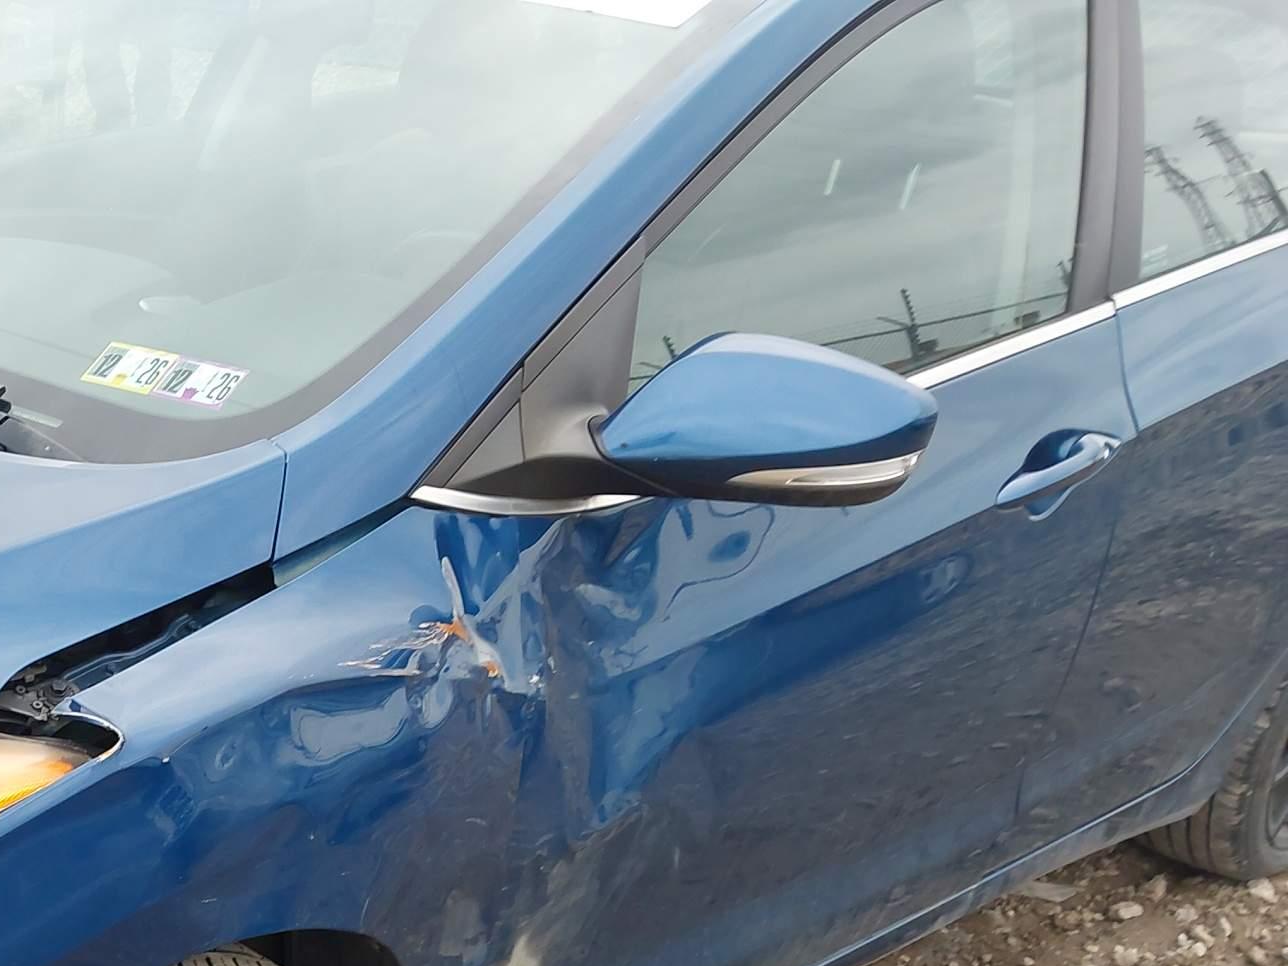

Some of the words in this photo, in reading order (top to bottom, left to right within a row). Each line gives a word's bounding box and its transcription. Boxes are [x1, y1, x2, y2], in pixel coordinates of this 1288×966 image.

[90, 353, 123, 379] 12
[136, 357, 170, 386] 26
[161, 367, 193, 394] 12
[206, 372, 241, 401] 26
